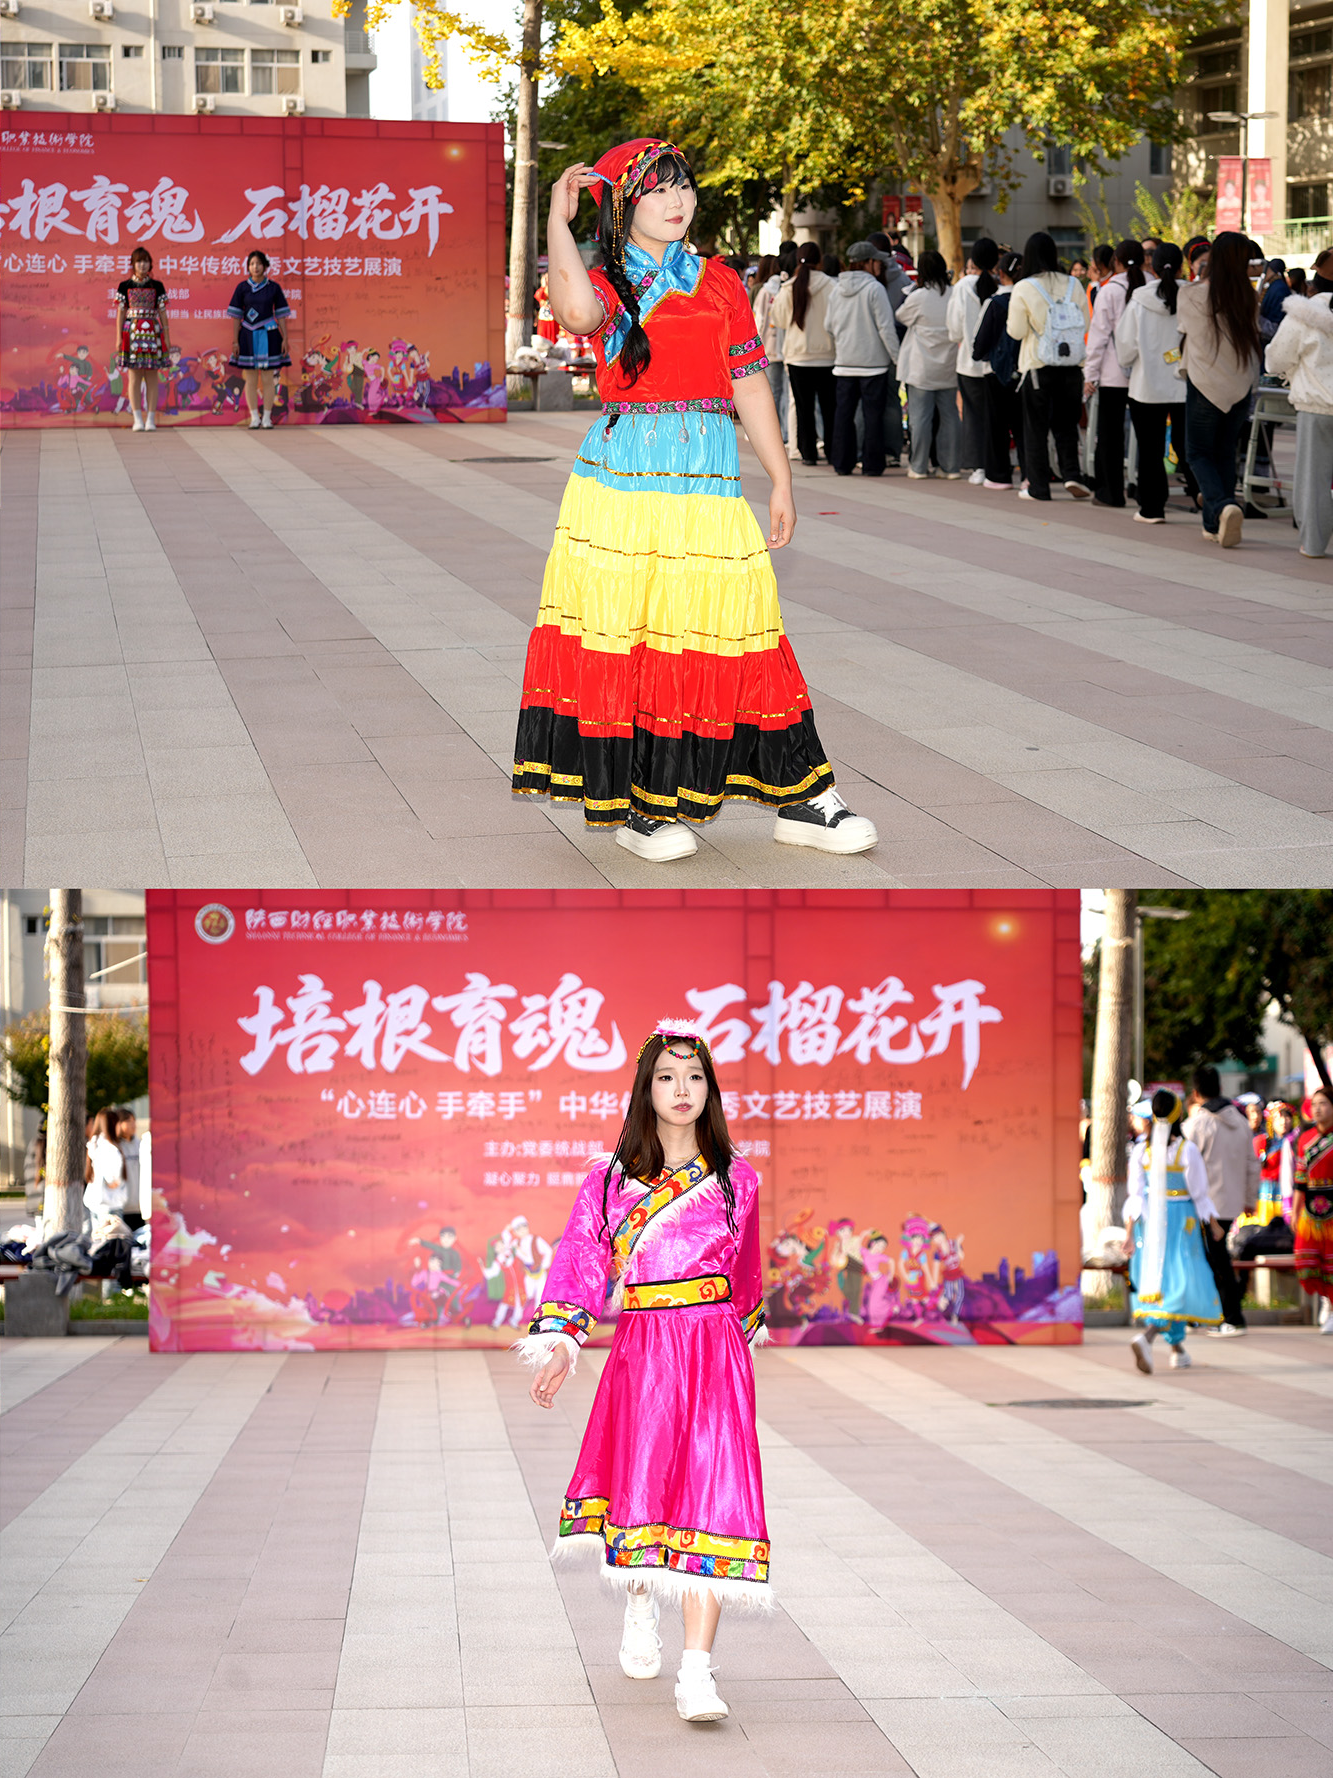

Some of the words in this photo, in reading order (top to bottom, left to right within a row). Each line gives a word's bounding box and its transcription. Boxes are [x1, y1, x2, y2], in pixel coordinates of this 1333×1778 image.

[0, 175, 204, 245] 根育魂
[211, 182, 454, 257] 石榴花开
[238, 973, 627, 1077] 培根育魂
[685, 977, 1003, 1091] 石榴花开
[560, 1088, 923, 1121] 中华秀文艺技艺展演
